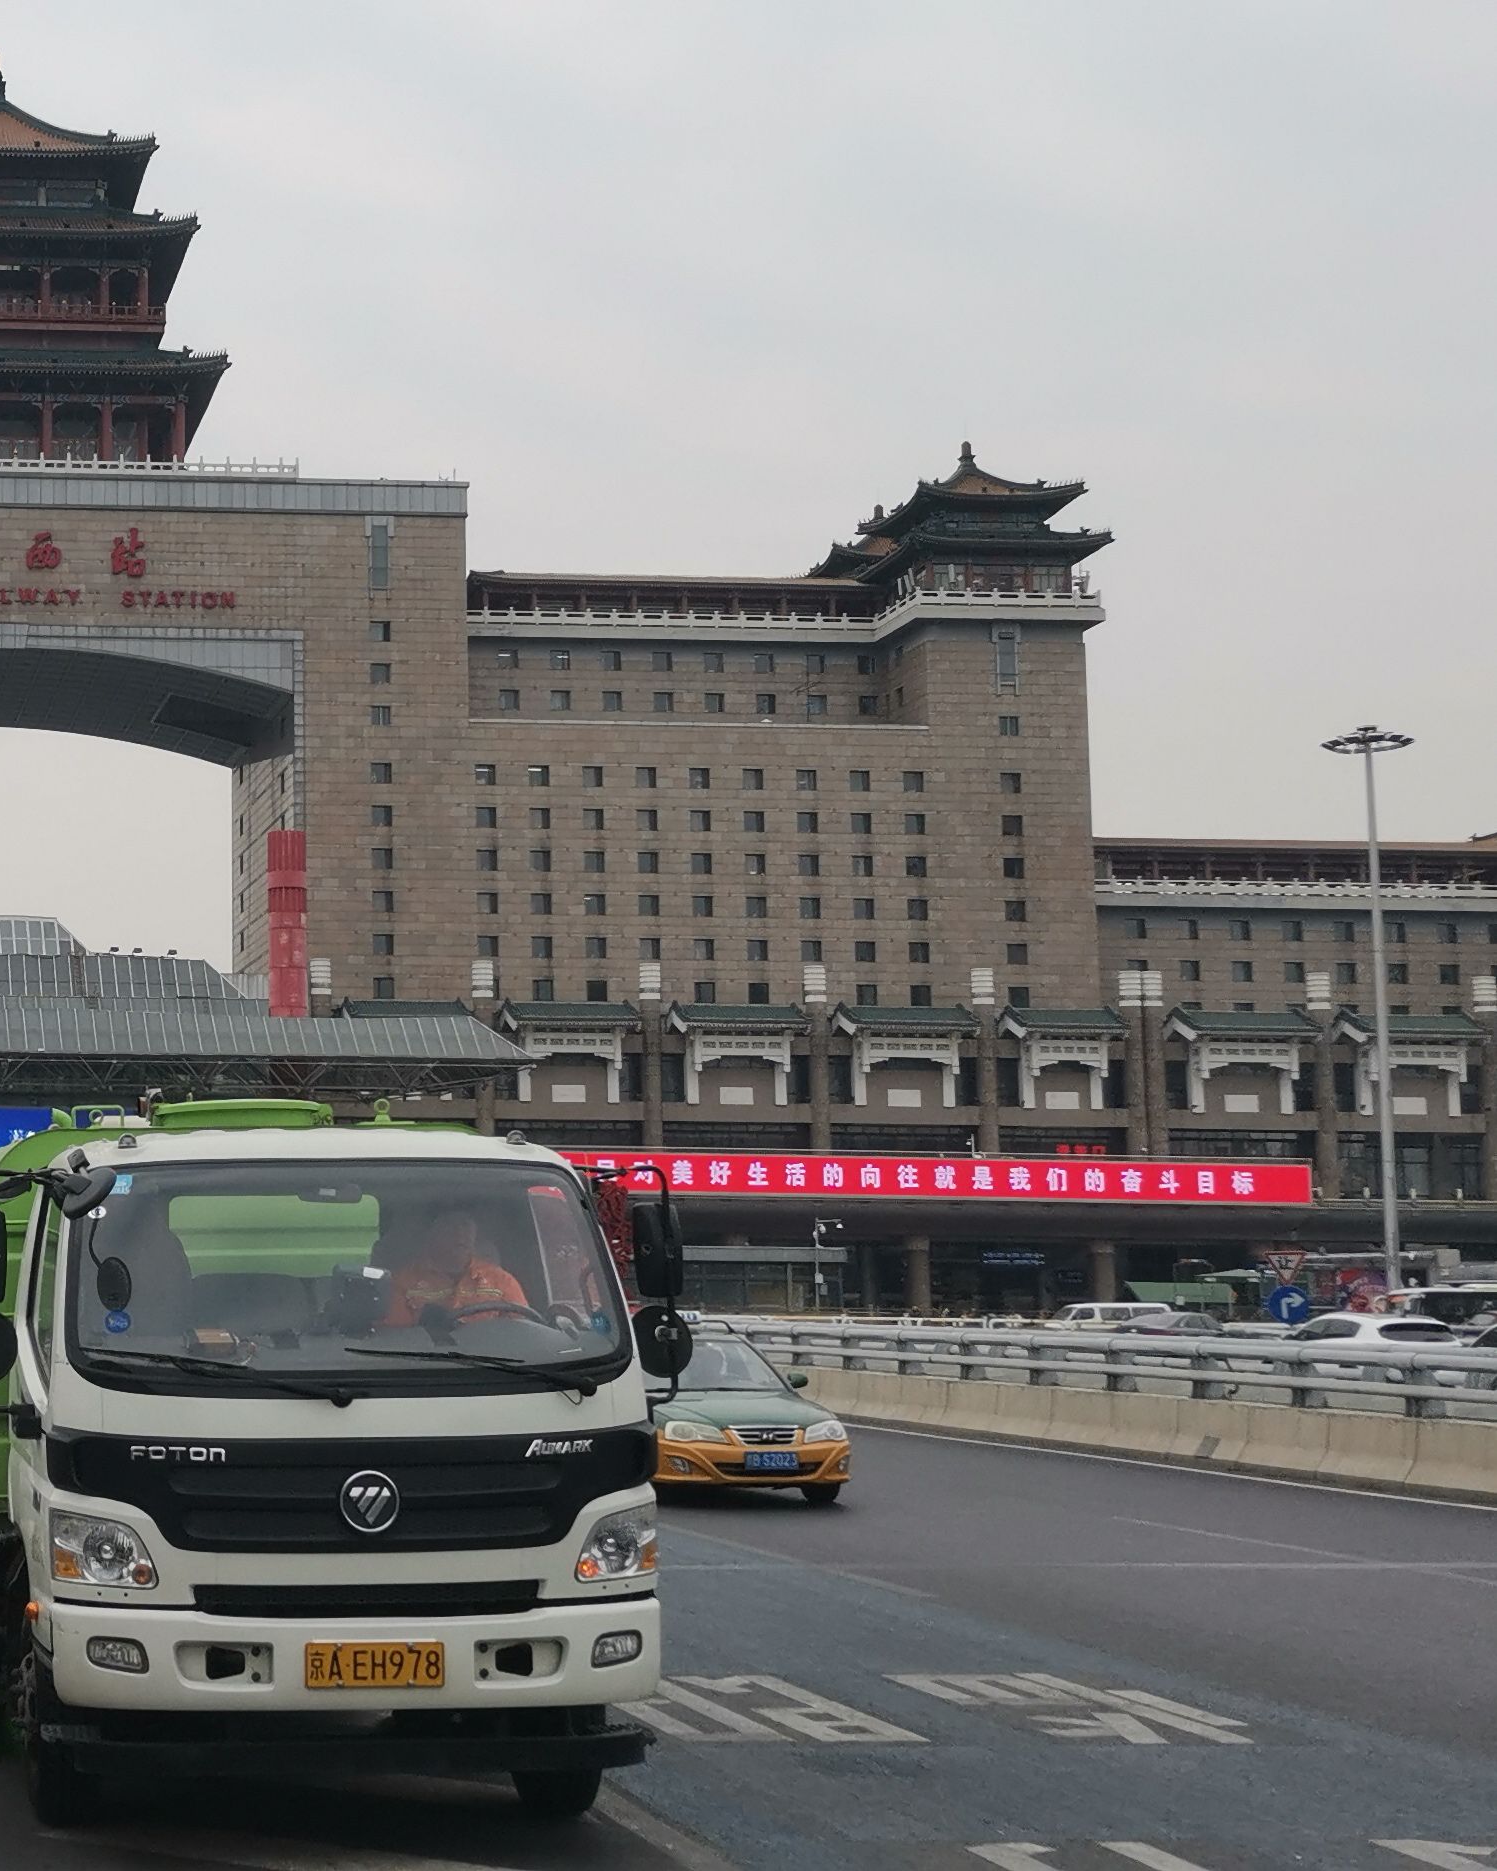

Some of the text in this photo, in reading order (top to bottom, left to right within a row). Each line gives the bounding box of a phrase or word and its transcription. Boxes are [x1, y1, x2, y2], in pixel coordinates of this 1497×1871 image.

[120, 589, 236, 610] STATION
[1275, 1256, 1295, 1270] 让
[130, 1446, 226, 1463] FOTON
